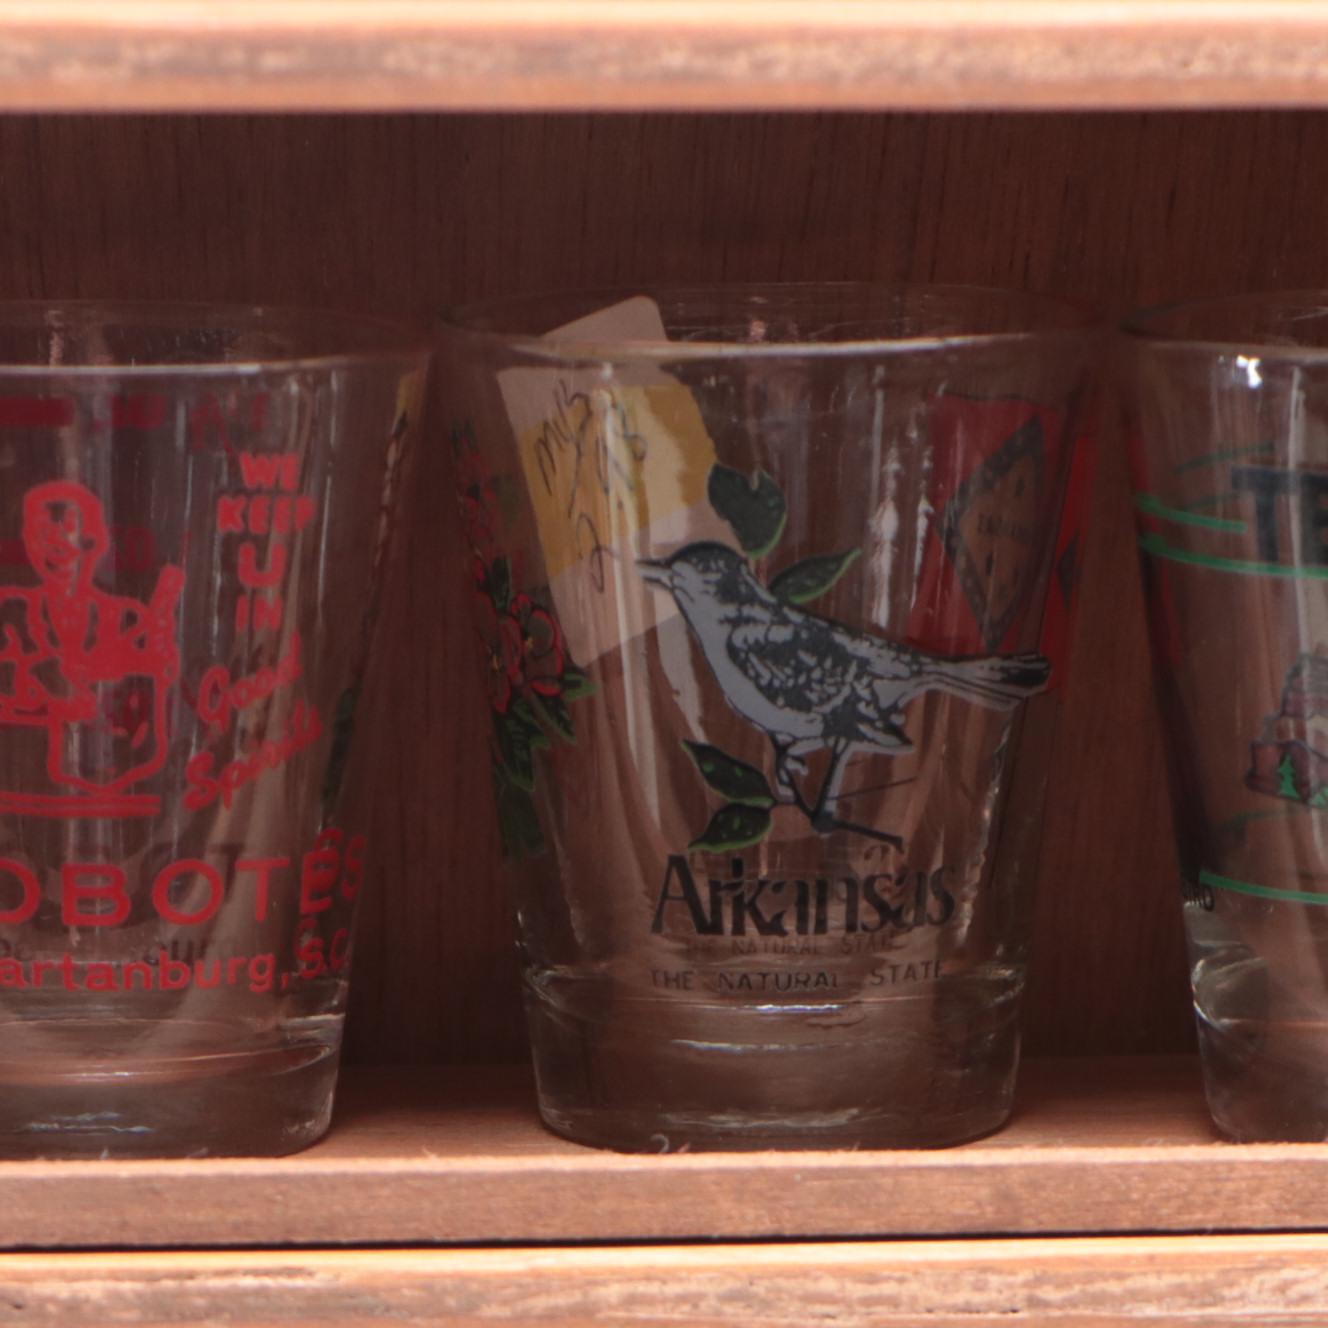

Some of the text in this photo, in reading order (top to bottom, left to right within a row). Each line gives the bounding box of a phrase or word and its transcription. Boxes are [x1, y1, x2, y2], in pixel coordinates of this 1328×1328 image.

[238, 451, 301, 491] WE
[216, 494, 315, 536] KEEP
[237, 540, 287, 588] U
[234, 594, 283, 633] IN
[650, 853, 959, 937] Arkansas
[650, 968, 695, 992] THE
[716, 970, 840, 994] NATURAL
